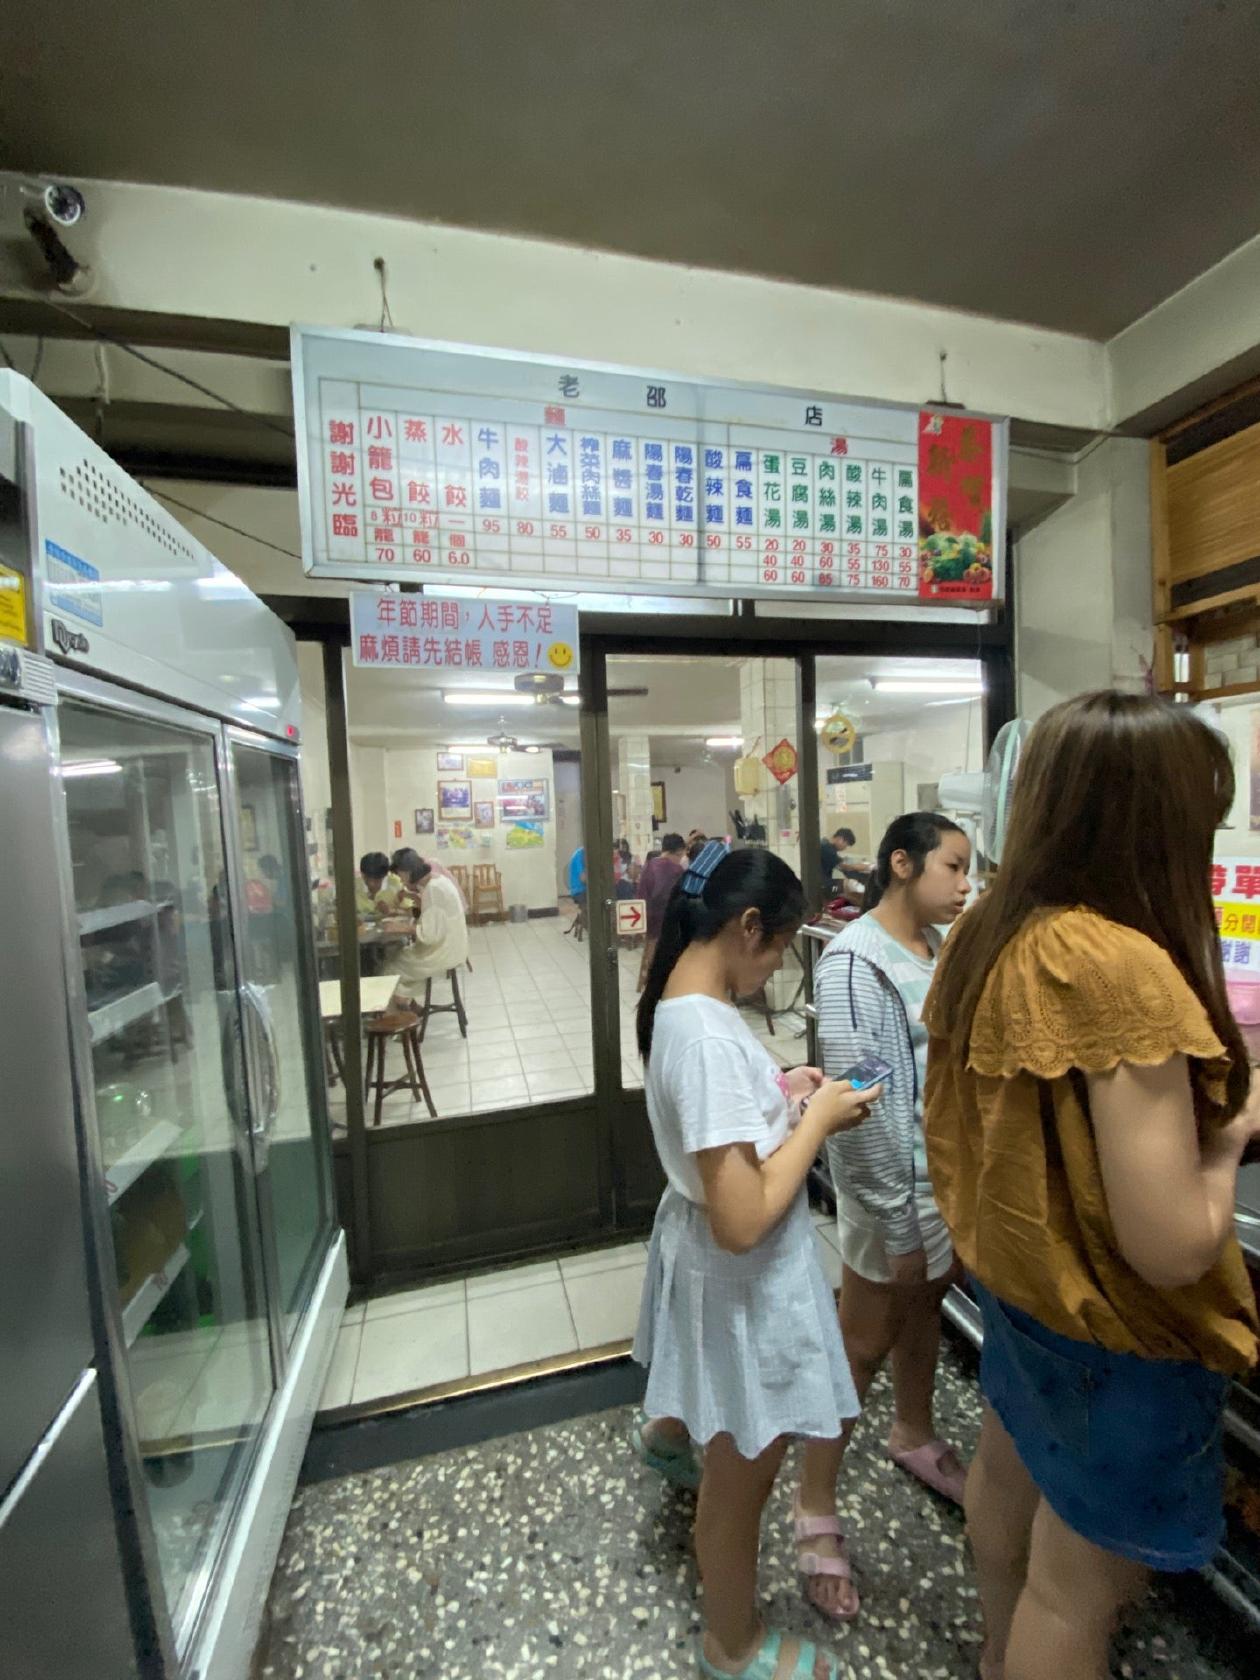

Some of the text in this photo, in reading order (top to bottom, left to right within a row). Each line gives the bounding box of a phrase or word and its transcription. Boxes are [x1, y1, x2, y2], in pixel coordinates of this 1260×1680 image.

[557, 374, 824, 427] 老 邵 店
[829, 436, 849, 456] 湯
[366, 415, 395, 502] 小籠包
[403, 418, 431, 505] 蒸餃
[441, 423, 467, 508] 水餃
[477, 427, 502, 509] 牛肉麵
[328, 419, 358, 538] 謝謝光臨
[612, 439, 633, 518] 麻醬麵
[644, 443, 664, 521] 陽春湯麵
[674, 445, 695, 523] 陽春乾麵
[704, 448, 725, 524] 酸辣麵
[735, 450, 754, 526] 扁食麵
[762, 453, 782, 530] 蛋花湯
[790, 456, 810, 530] 豆腐湯
[818, 460, 837, 533] 肉絲湯
[845, 463, 863, 535] 酸辣湯
[871, 466, 889, 538] 牛肉湯
[897, 469, 915, 539] 扁食湯
[482, 518, 501, 533] 95
[549, 524, 567, 538] 55
[584, 526, 601, 540] 50
[449, 533, 466, 548] 個
[616, 528, 632, 542] 35
[648, 531, 664, 545] 30
[679, 533, 694, 547] 30
[706, 535, 721, 549] 50
[735, 535, 752, 550] 55
[764, 538, 779, 552] 20
[791, 539, 807, 553] 20
[820, 542, 834, 555] 30
[847, 542, 861, 555] 35
[875, 544, 889, 558] 75
[898, 546, 912, 559] 30
[375, 547, 395, 562] 70
[412, 548, 432, 563] 60
[448, 550, 471, 565] 6.0
[763, 554, 778, 567] 40
[790, 554, 805, 567] 40
[819, 556, 834, 569] 60
[847, 557, 861, 572] 55
[871, 559, 890, 573] 130
[898, 560, 912, 574] 55
[763, 569, 778, 582] 60
[791, 570, 806, 584] 60
[847, 573, 861, 587] 75
[897, 576, 911, 588] 70
[376, 597, 553, 635] 年節期間，人手不足
[359, 632, 483, 668] 麻煩請先結帳
